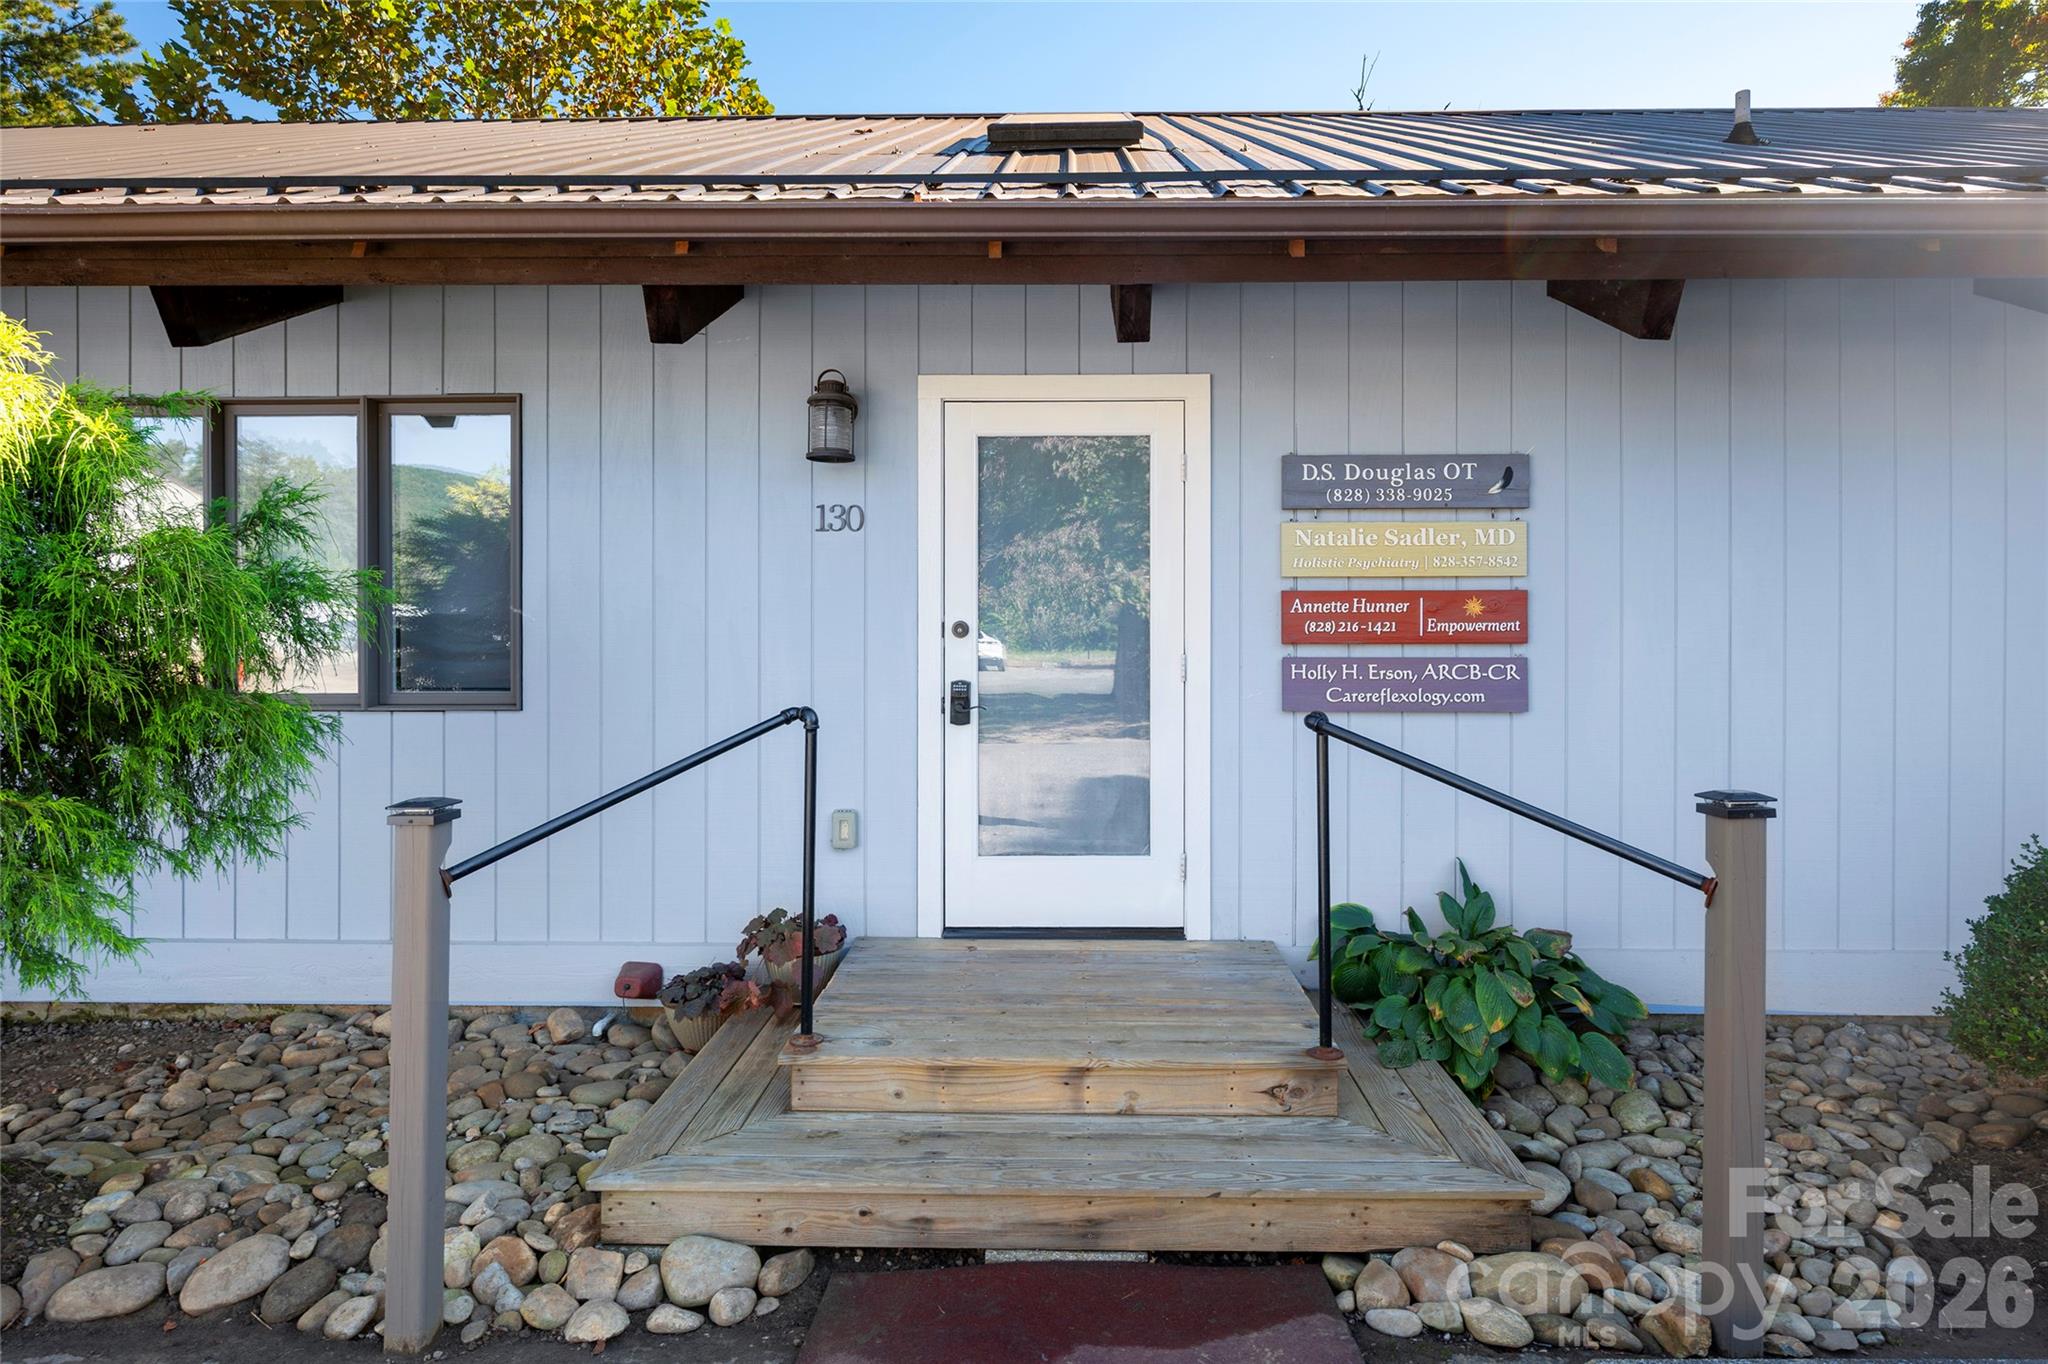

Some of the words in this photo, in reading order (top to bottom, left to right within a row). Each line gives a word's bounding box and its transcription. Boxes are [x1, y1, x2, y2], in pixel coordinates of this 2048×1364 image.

[1344, 462, 1436, 487] Douglas
[1443, 462, 1478, 480] OT
[1326, 488, 1370, 504] (828)
[1376, 488, 1452, 502] 338-9025
[815, 504, 865, 532] 130
[1295, 528, 1378, 546] Natalie
[1384, 528, 1467, 548] Sadler,
[1473, 528, 1516, 546] MD
[1292, 557, 1344, 569] Holistic
[1347, 557, 1420, 570] Psychiatry
[1432, 556, 1518, 568] 828-357-8542
[1290, 598, 1349, 614] Annette
[1352, 598, 1410, 614] Hunner
[1304, 620, 1335, 635] (828)
[1337, 621, 1397, 634] 216-1421
[1427, 618, 1521, 636] Empowerment
[1290, 664, 1337, 683] Holly
[1342, 664, 1363, 680] H.
[1368, 664, 1418, 684] Erson,
[1421, 663, 1521, 681] ARCB-CR
[1326, 687, 1486, 706] Carereflexology.com
